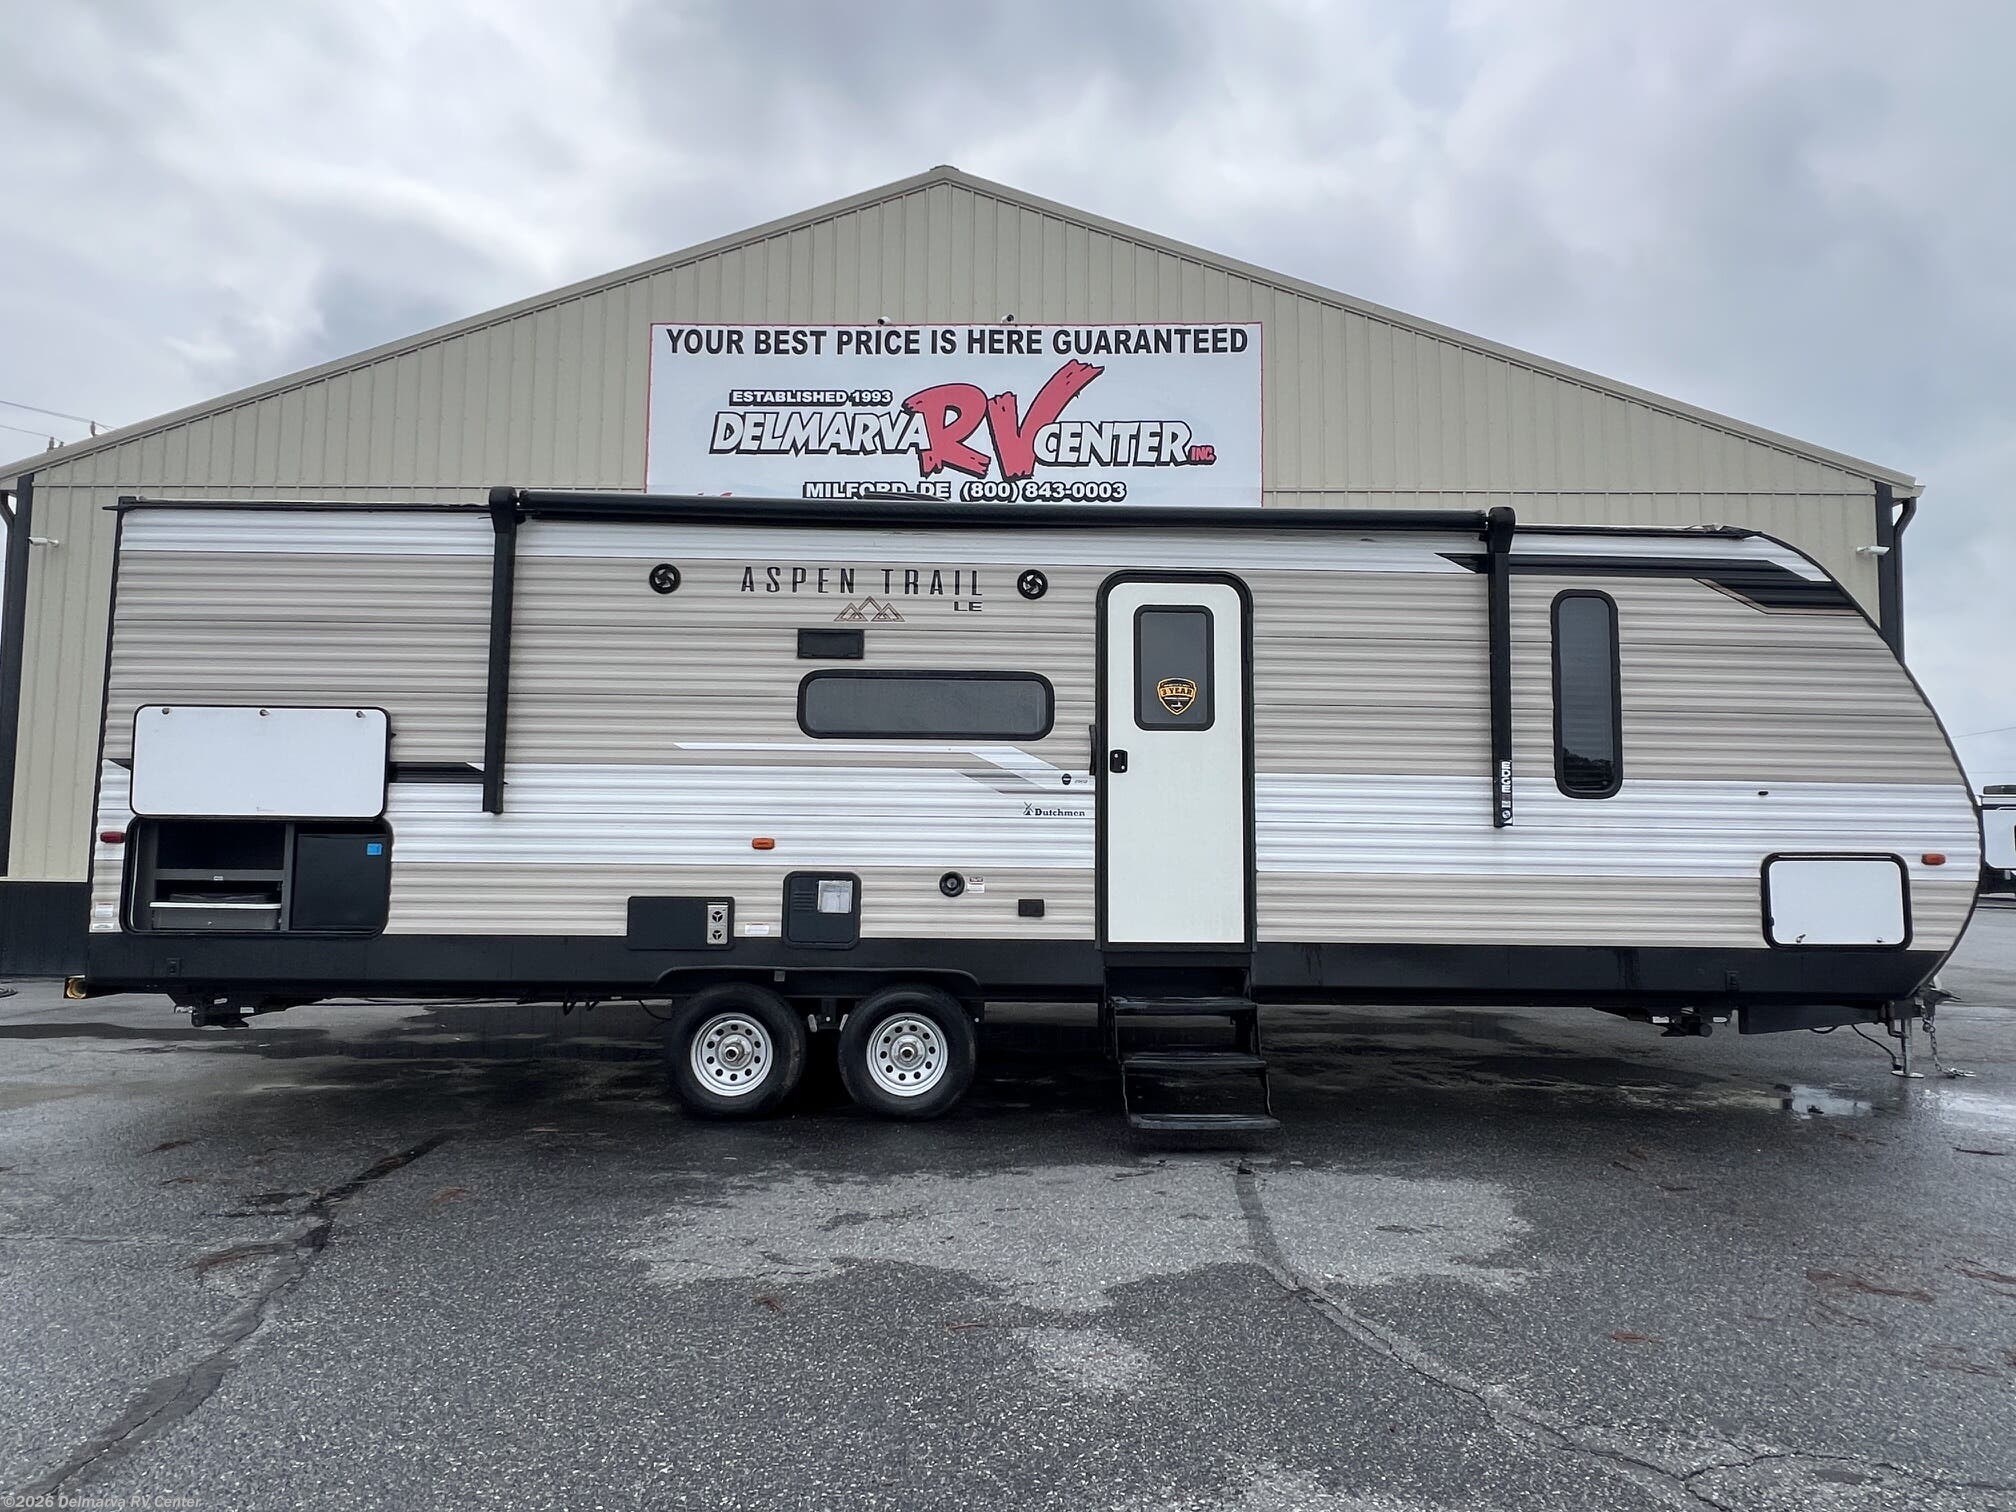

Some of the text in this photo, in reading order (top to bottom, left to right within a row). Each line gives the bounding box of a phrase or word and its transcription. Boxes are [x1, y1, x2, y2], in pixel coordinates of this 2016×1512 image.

[666, 328, 1248, 355] YOUR BEST PRICE IS HERE GUARANTEED
[730, 389, 893, 405] ESTABLISHED 1993
[709, 411, 932, 456] DELMARVA
[901, 359, 1105, 482] RV
[1033, 420, 1192, 466] CENTER
[803, 481, 1126, 503] MILFORD DE (800) 843-0003
[740, 566, 983, 596] ASPEN TRAIL
[953, 601, 983, 612] LE
[1168, 687, 1193, 696] YEAR
[1035, 808, 1086, 817] Dutchmen
